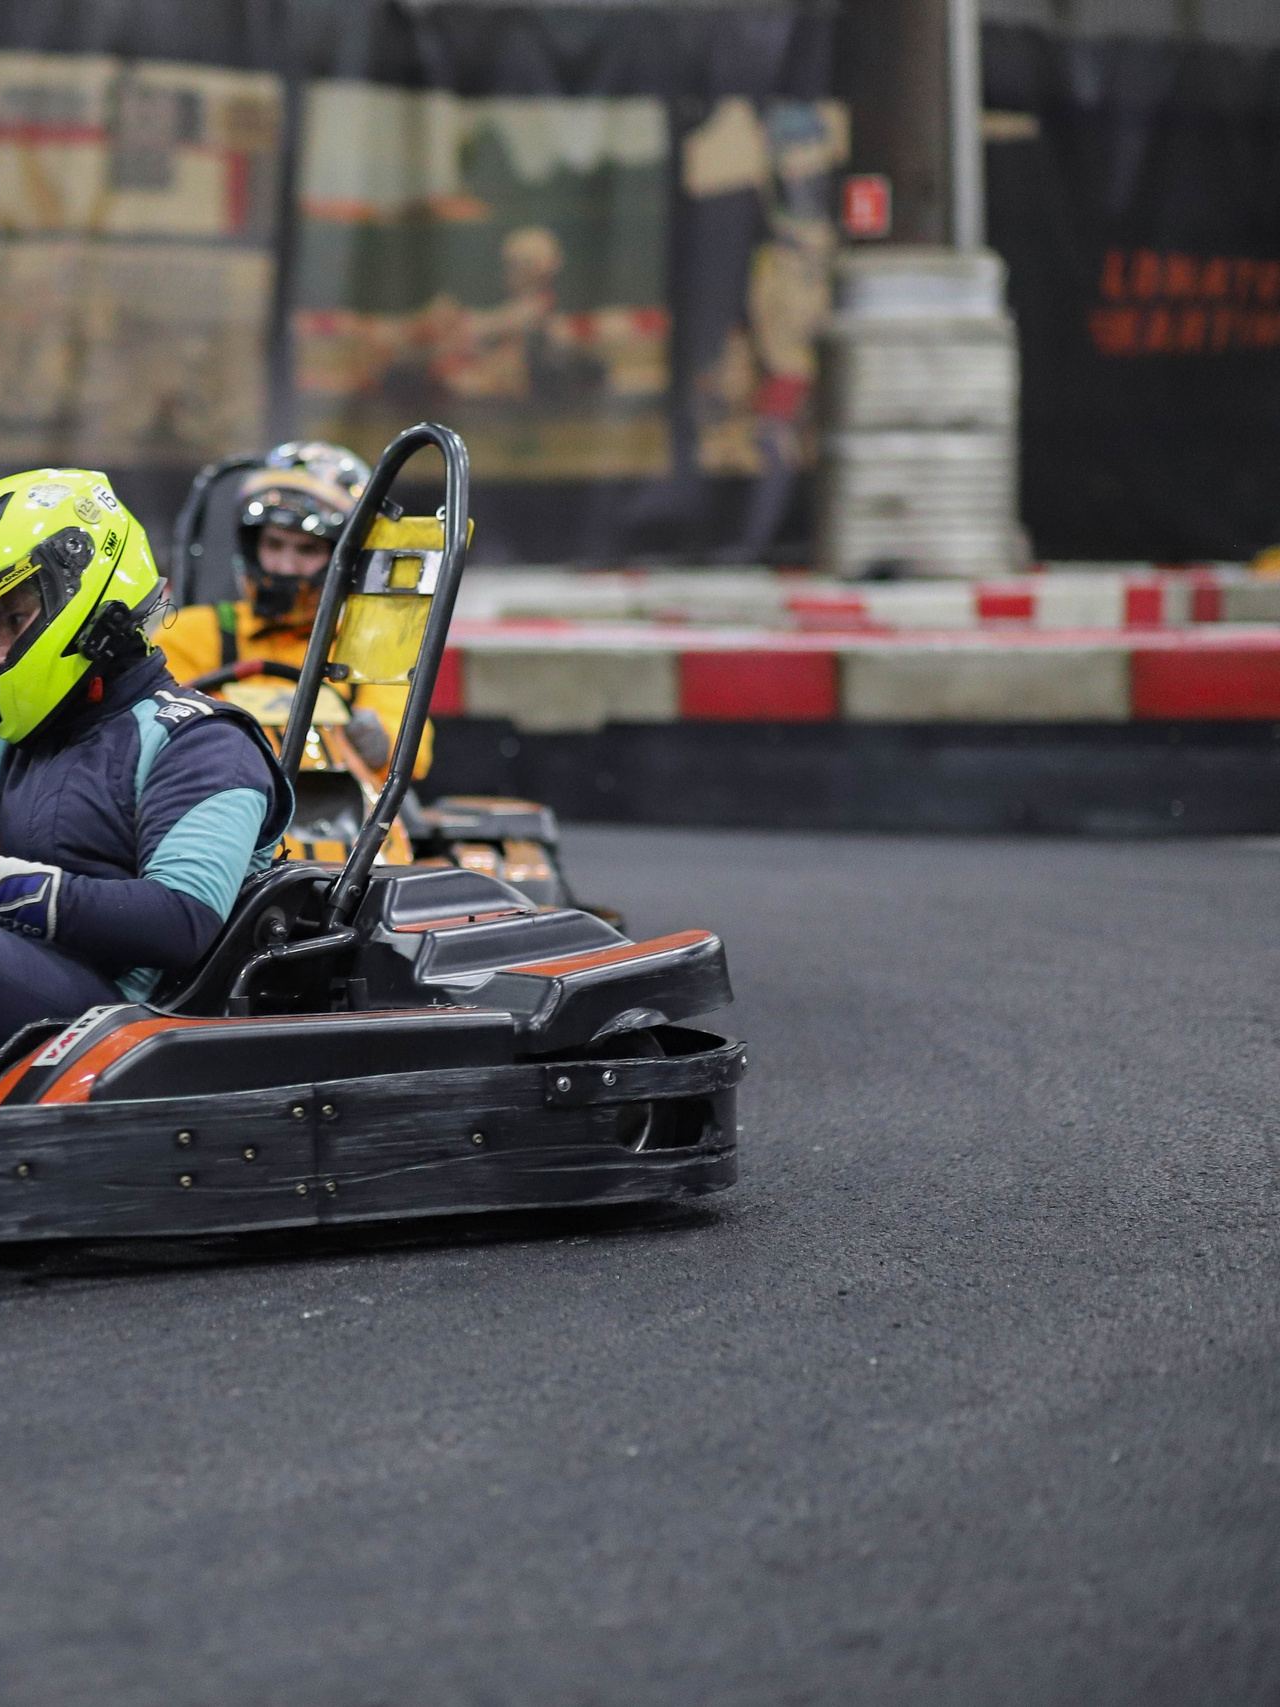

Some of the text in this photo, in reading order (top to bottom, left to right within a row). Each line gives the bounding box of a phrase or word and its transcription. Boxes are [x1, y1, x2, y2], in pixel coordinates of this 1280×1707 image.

[97, 490, 118, 511] 15
[104, 531, 119, 558] OMP
[160, 705, 191, 718] OMP
